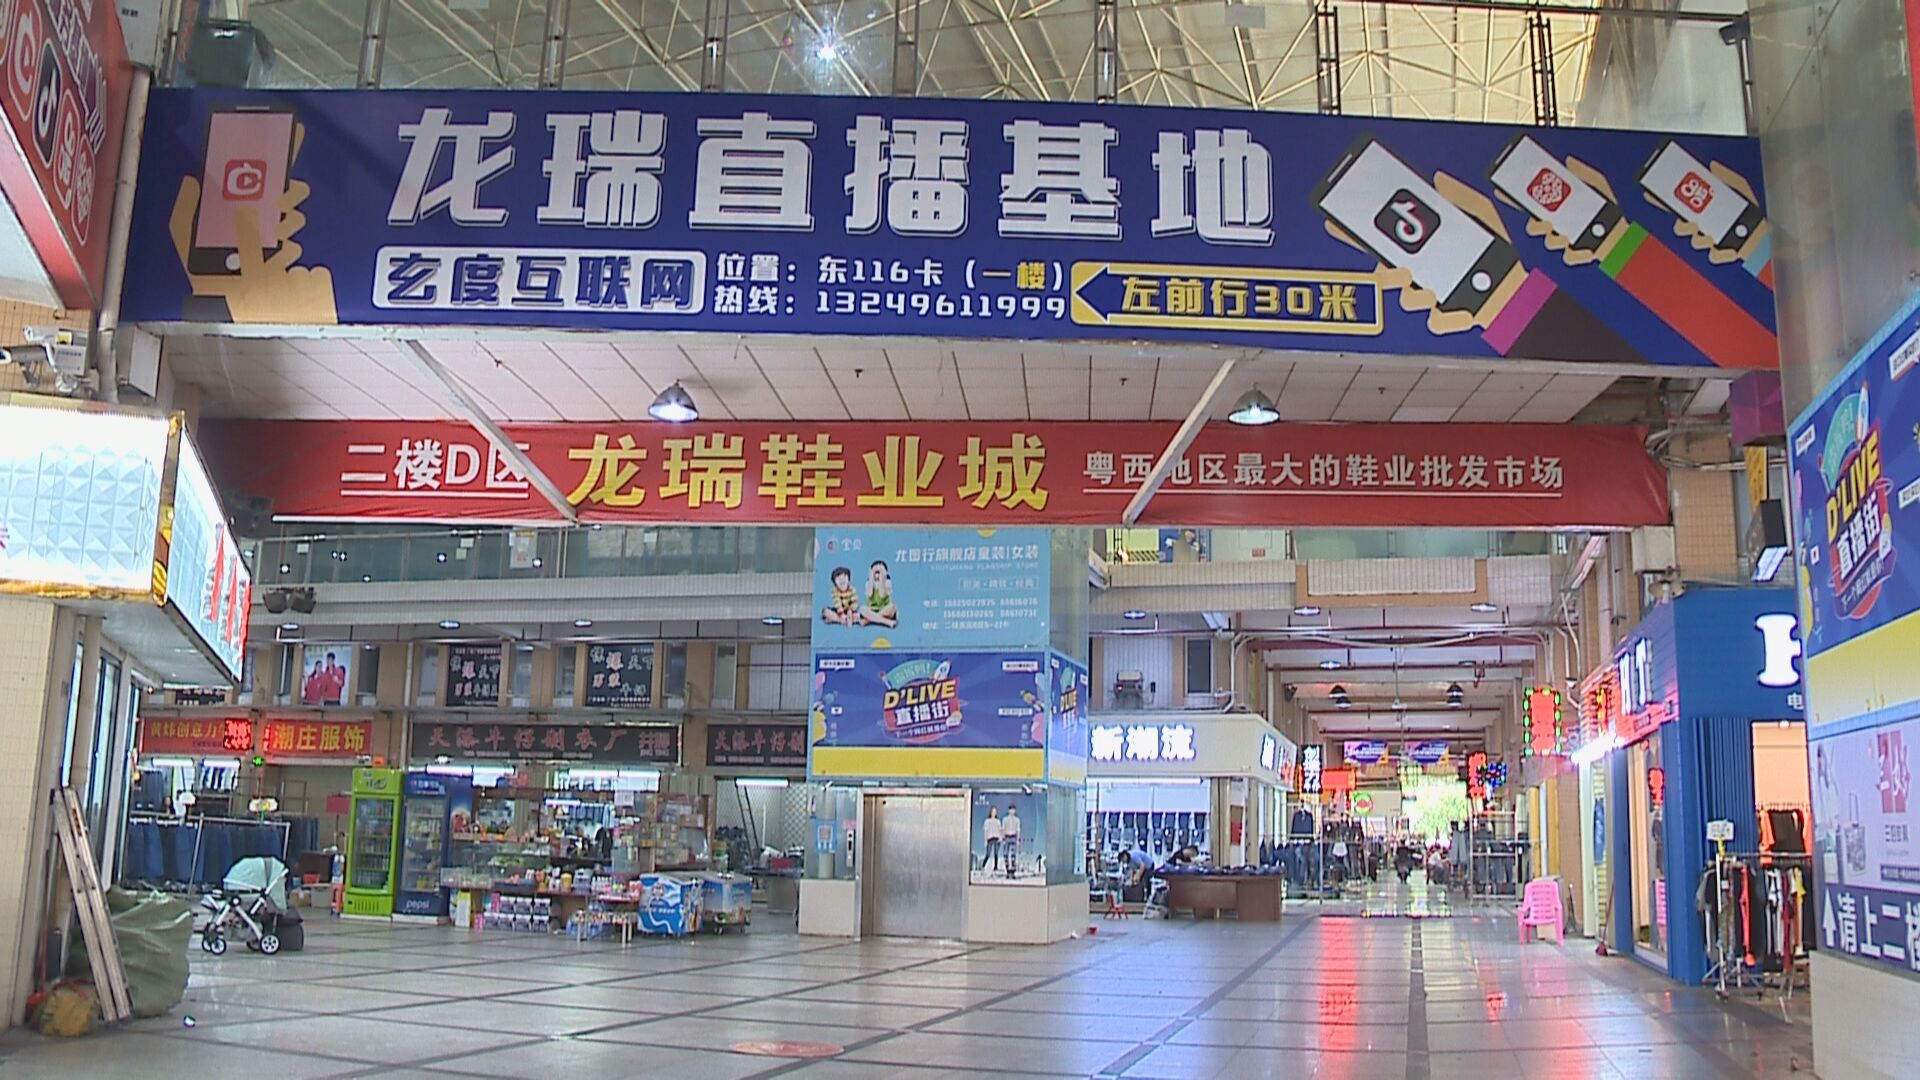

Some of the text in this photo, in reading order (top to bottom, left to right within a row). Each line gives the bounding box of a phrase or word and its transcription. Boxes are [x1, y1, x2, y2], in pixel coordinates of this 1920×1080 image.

[387, 107, 1275, 245] 龙瑞直播基地
[387, 252, 696, 310] 玄度互联网
[1121, 276, 1358, 321] 左前行30米
[341, 437, 530, 491] 二楼D区
[566, 432, 1050, 511] 龙瑞鞋业城
[1083, 450, 1565, 489] 粤西地区最大的鞋业批发市场
[1837, 490, 1881, 581] 直播街
[883, 679, 957, 711] D'LIVE
[894, 700, 950, 726] 直播街
[272, 723, 365, 752] 潮庄服饰
[1090, 724, 1196, 762] 新潮流
